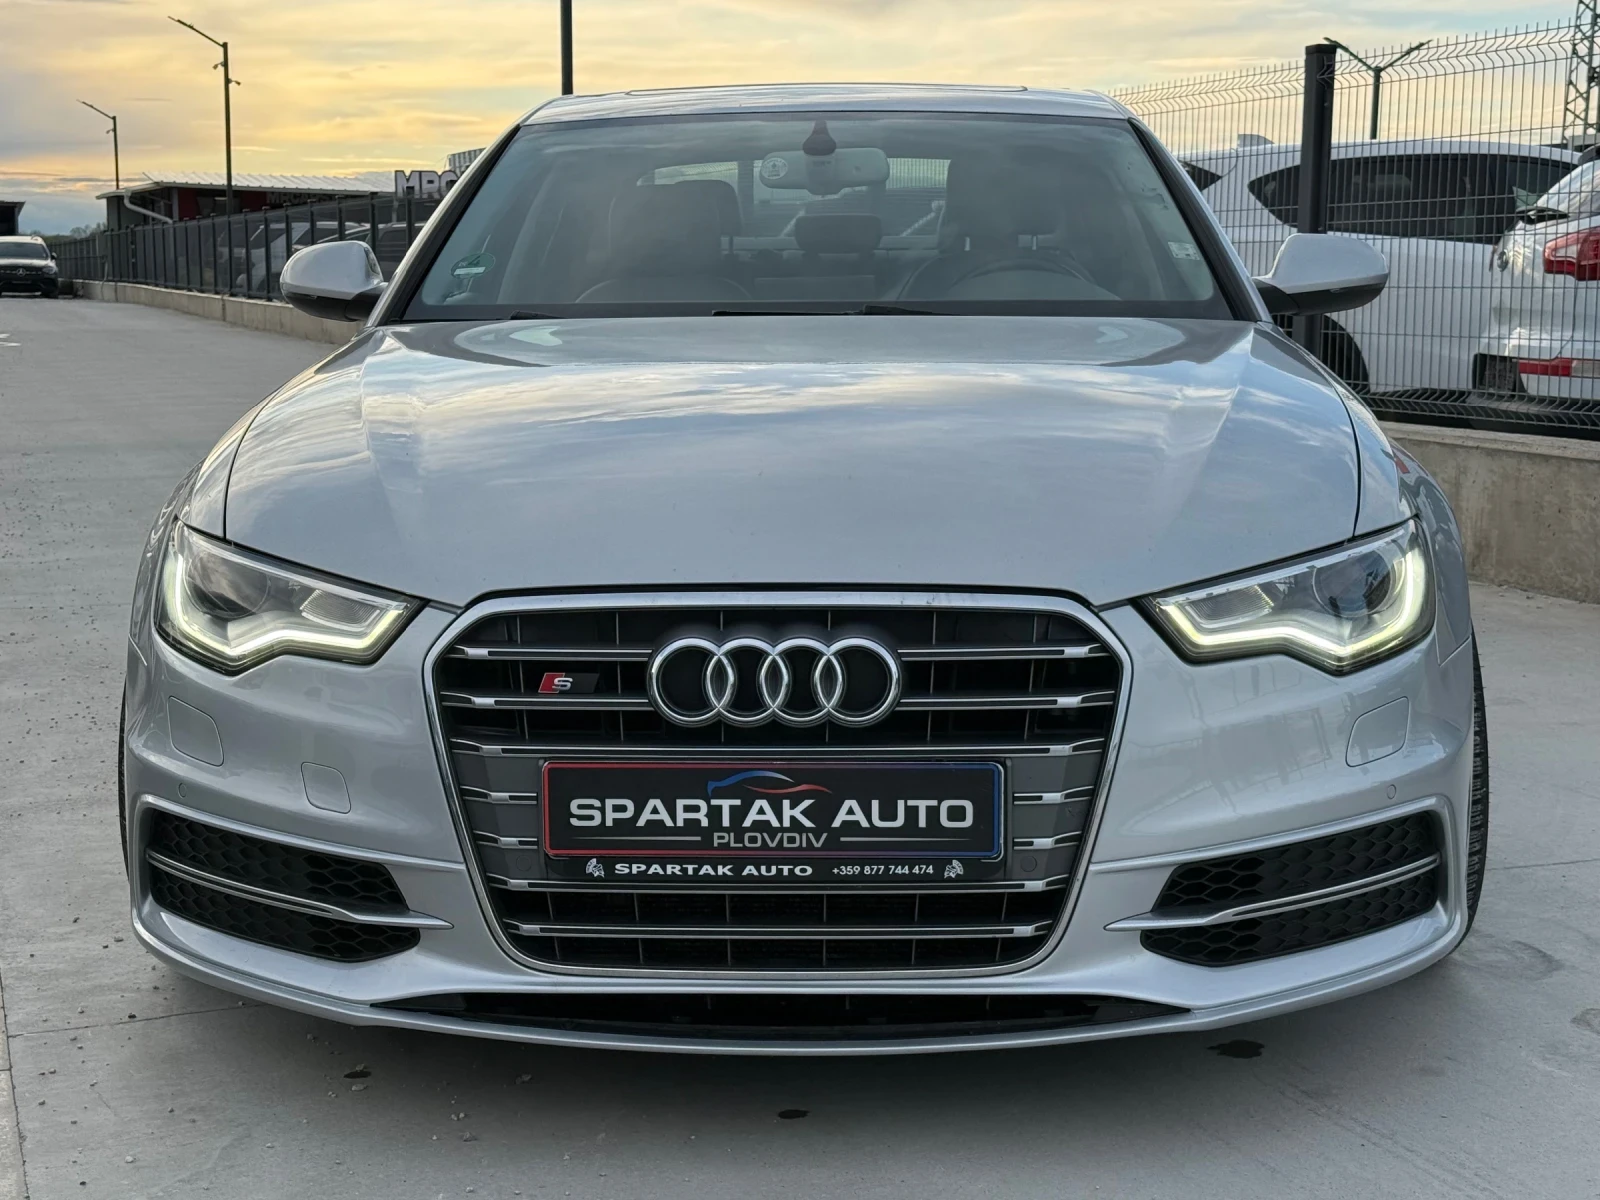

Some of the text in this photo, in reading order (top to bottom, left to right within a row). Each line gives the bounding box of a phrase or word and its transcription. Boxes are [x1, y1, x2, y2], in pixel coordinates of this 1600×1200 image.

[552, 677, 573, 690] S
[569, 798, 974, 828] SPARTAK AUTO
[713, 832, 828, 848] PLOVDIV
[614, 863, 934, 876] SPARTAK AUTO +359 877 744 474
